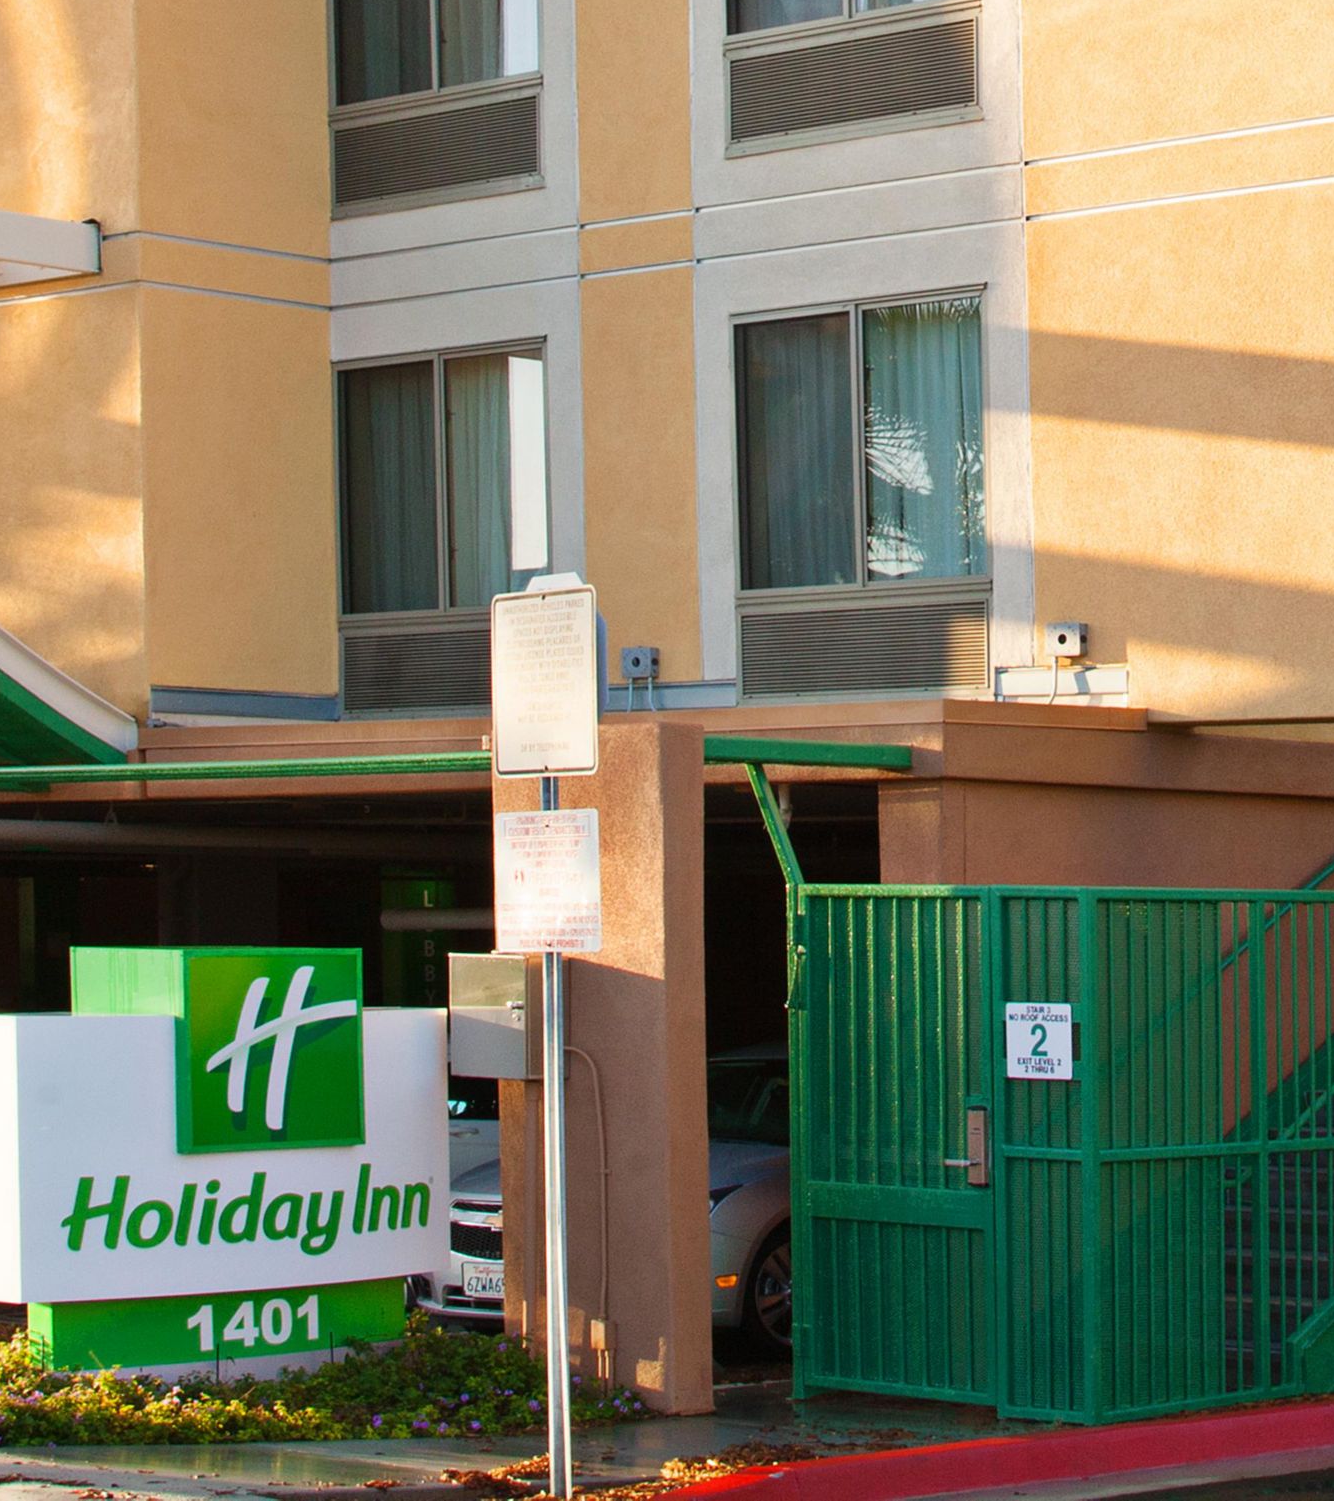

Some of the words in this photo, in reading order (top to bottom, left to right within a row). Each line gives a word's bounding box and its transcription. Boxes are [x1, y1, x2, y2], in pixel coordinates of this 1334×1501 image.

[423, 889, 435, 1005] LBBY
[1009, 1013, 1019, 1021] NO
[1041, 1014, 1068, 1022] ACCESS
[1030, 1023, 1048, 1057] 2
[1017, 1057, 1032, 1065] EXIT
[1034, 1057, 1055, 1066] LEVEL
[1031, 1066, 1049, 1074] THRU
[61, 1171, 344, 1255] Holiday
[352, 1163, 430, 1235] Inn
[187, 1295, 320, 1352] 1401
